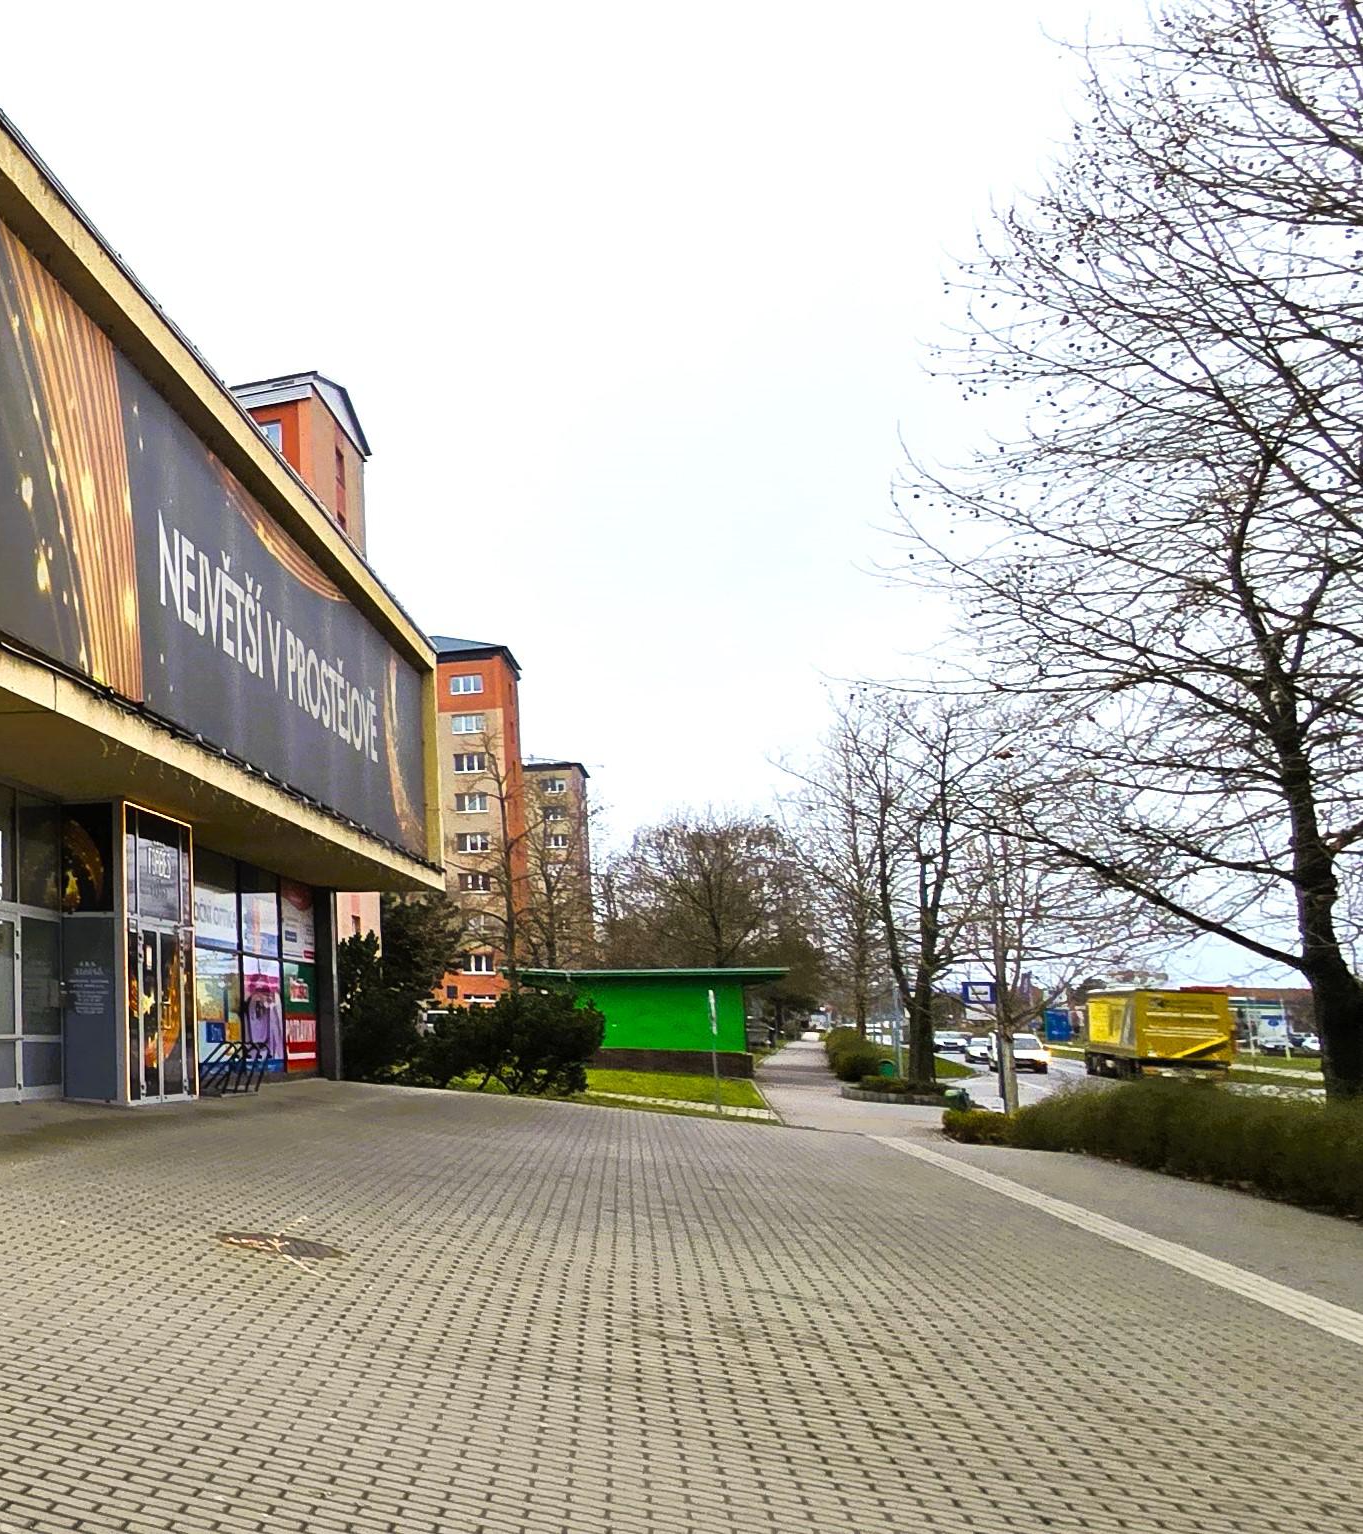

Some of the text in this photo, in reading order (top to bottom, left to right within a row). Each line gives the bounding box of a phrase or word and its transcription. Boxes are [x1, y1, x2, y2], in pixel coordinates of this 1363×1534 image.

[157, 508, 379, 764] NEJVĚTŠÍ V PROSTĚJOVĚ
